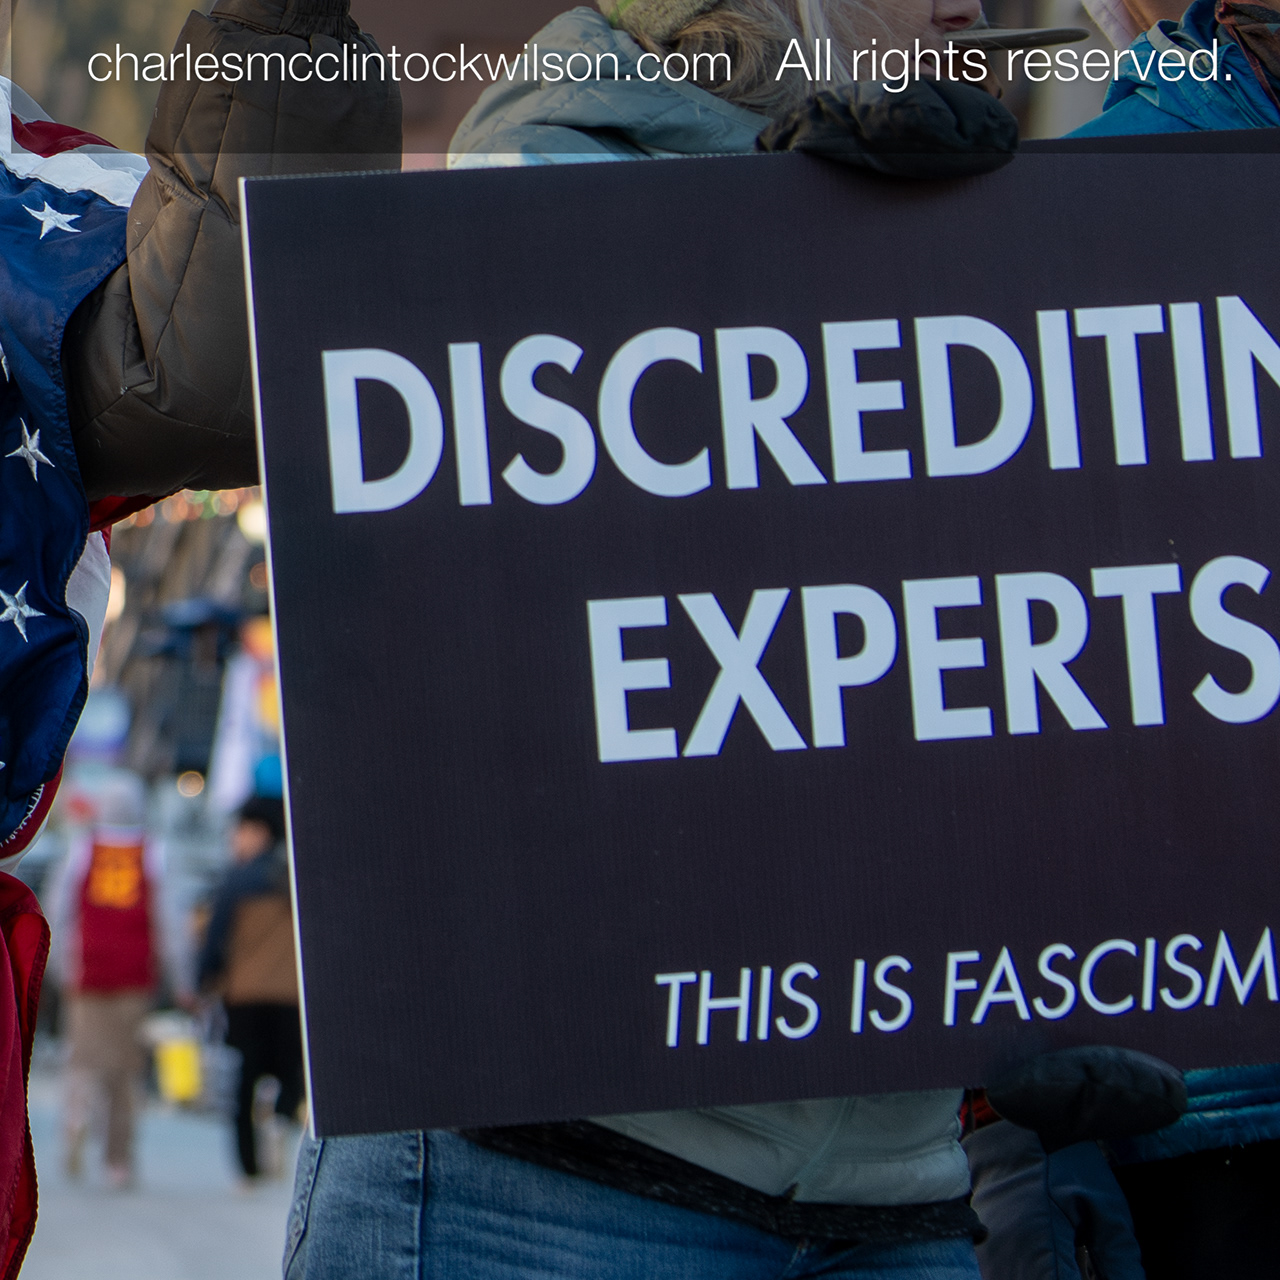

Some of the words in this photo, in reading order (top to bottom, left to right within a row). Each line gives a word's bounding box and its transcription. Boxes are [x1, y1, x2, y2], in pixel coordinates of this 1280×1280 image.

[586, 555, 1280, 763] EXPERTS
[655, 962, 819, 1047] THIS
[850, 955, 912, 1033] IS
[943, 927, 1280, 1026] FASCISM
